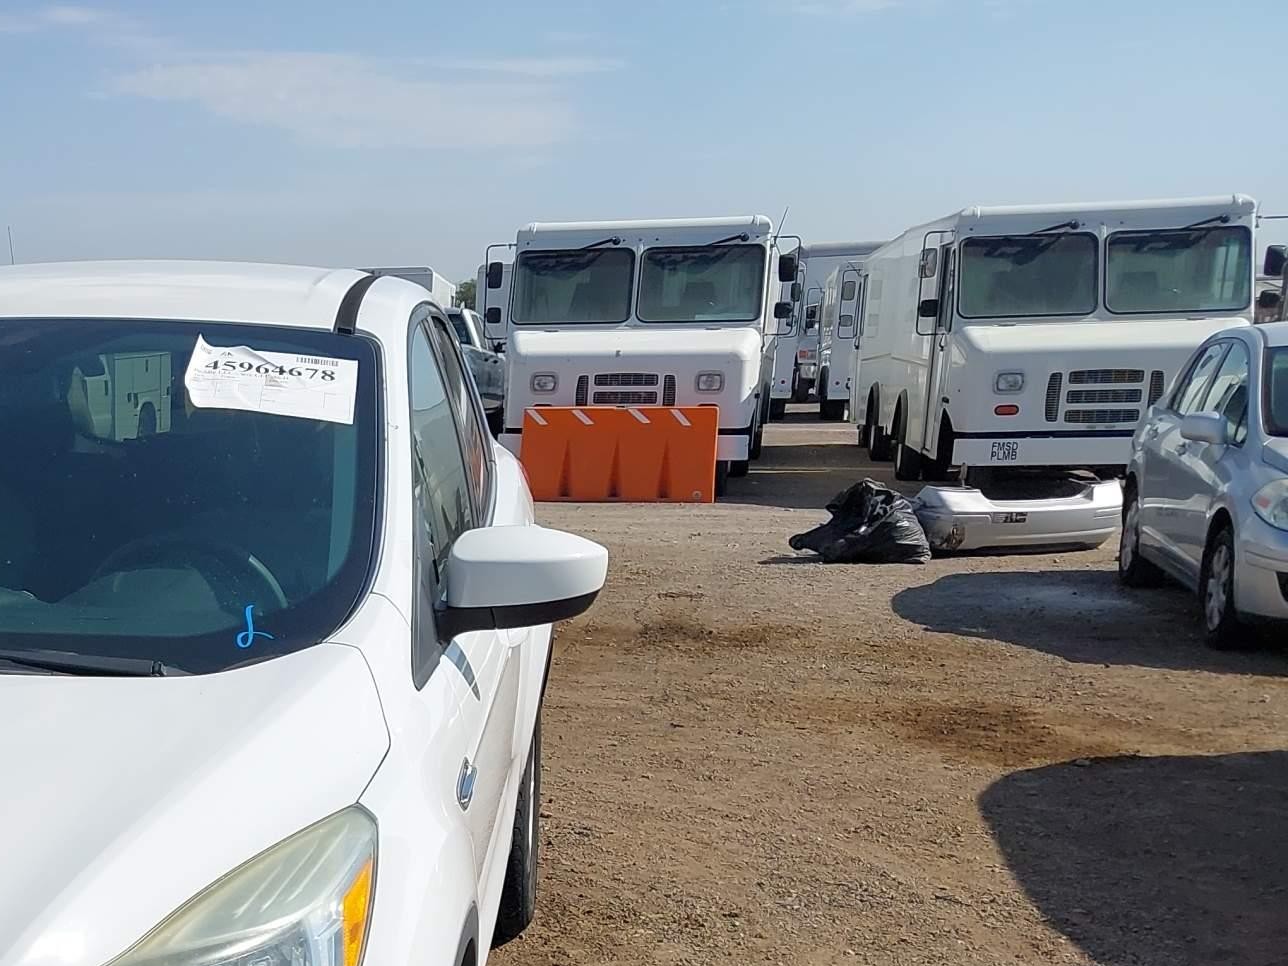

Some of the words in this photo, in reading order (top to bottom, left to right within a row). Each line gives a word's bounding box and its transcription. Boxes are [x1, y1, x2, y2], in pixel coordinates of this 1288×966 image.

[205, 359, 336, 382] 45964678
[992, 441, 1019, 451] FMSD
[991, 450, 1017, 461] PLMB
